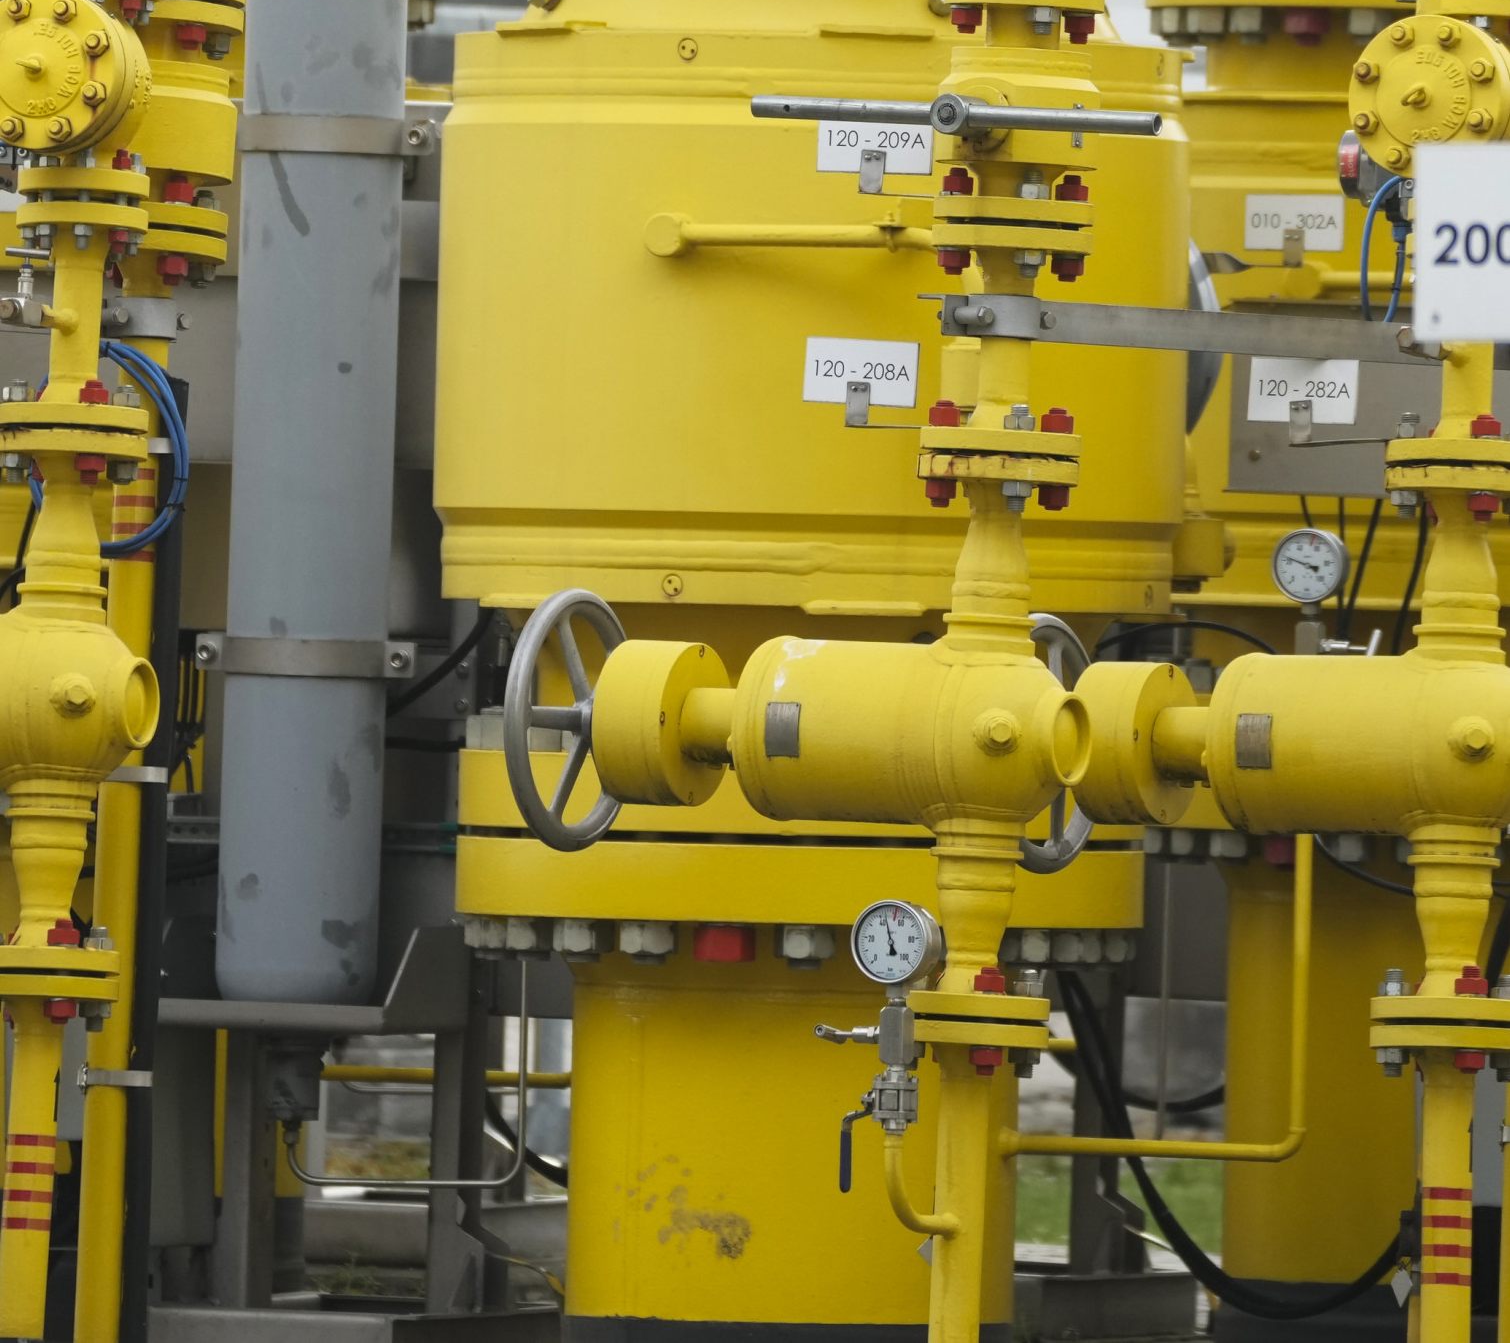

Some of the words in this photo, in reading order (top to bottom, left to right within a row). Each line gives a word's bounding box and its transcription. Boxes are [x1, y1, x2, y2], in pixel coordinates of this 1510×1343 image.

[827, 129, 859, 148] 120
[877, 131, 925, 149] 209A
[1251, 213, 1281, 229] 010
[1296, 214, 1337, 230] 302A
[814, 359, 845, 378] 120
[862, 362, 910, 381] 208A
[1258, 379, 1288, 397] 120
[1304, 380, 1350, 399] 282A
